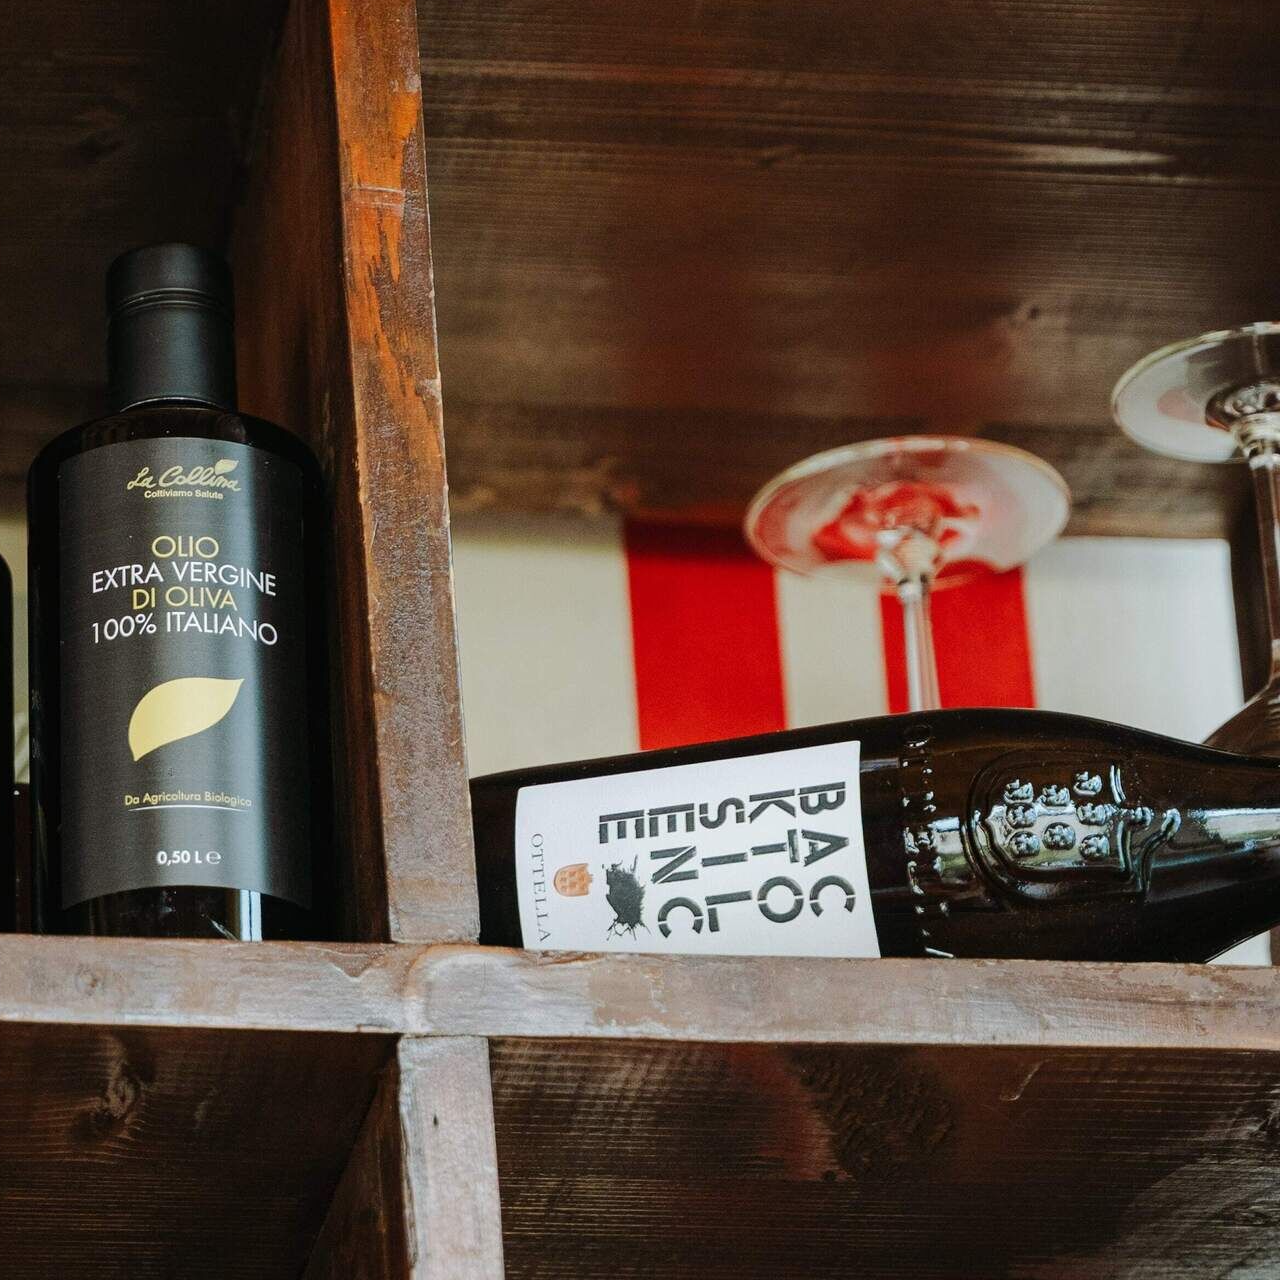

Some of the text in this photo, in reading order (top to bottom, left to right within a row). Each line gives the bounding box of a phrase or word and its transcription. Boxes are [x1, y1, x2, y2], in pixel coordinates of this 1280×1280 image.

[127, 467, 155, 490] La
[144, 489, 223, 499] Coltiviamo Salute
[152, 535, 219, 559] OLIO
[92, 561, 276, 596] EXTRA VERGINE
[132, 586, 237, 611] DI OLIVA
[92, 611, 278, 646] 100% ITALIANO
[125, 792, 252, 809] Da Agricoltura Biologica
[157, 850, 190, 866] 0,50
[195, 850, 202, 865] L
[530, 832, 551, 942] OTTELLA
